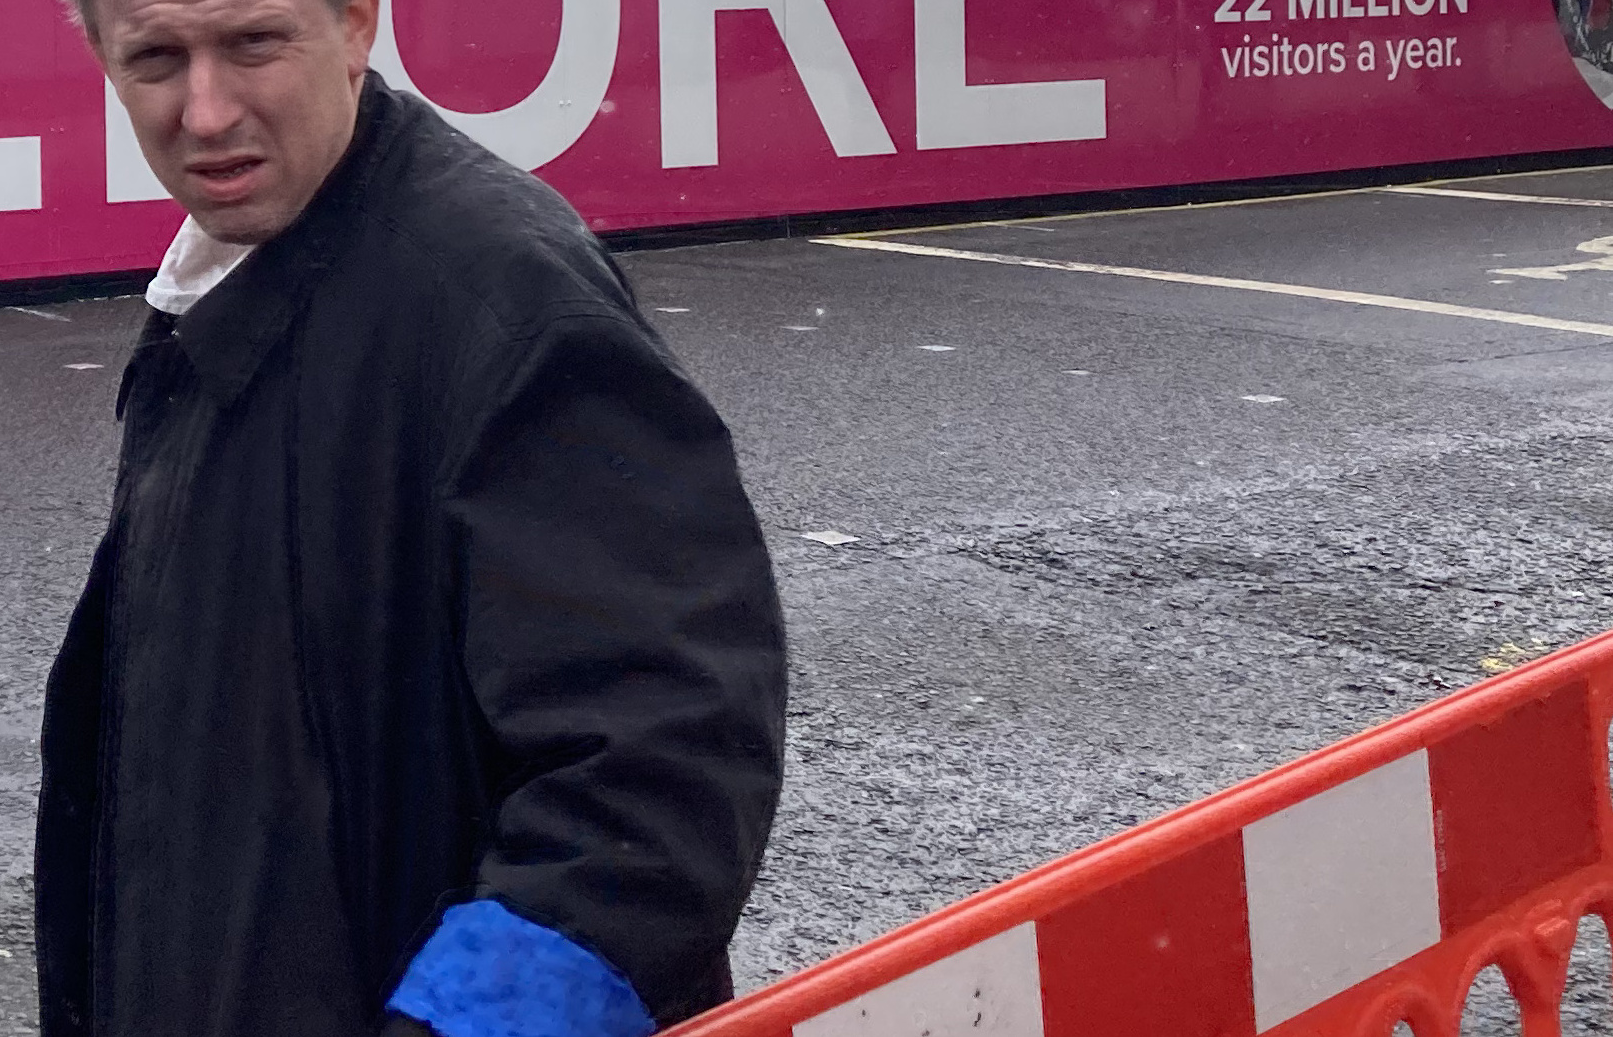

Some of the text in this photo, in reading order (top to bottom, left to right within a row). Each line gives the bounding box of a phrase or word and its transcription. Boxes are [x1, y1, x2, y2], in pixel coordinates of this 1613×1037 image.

[1221, 34, 1462, 81] visitors a year.
